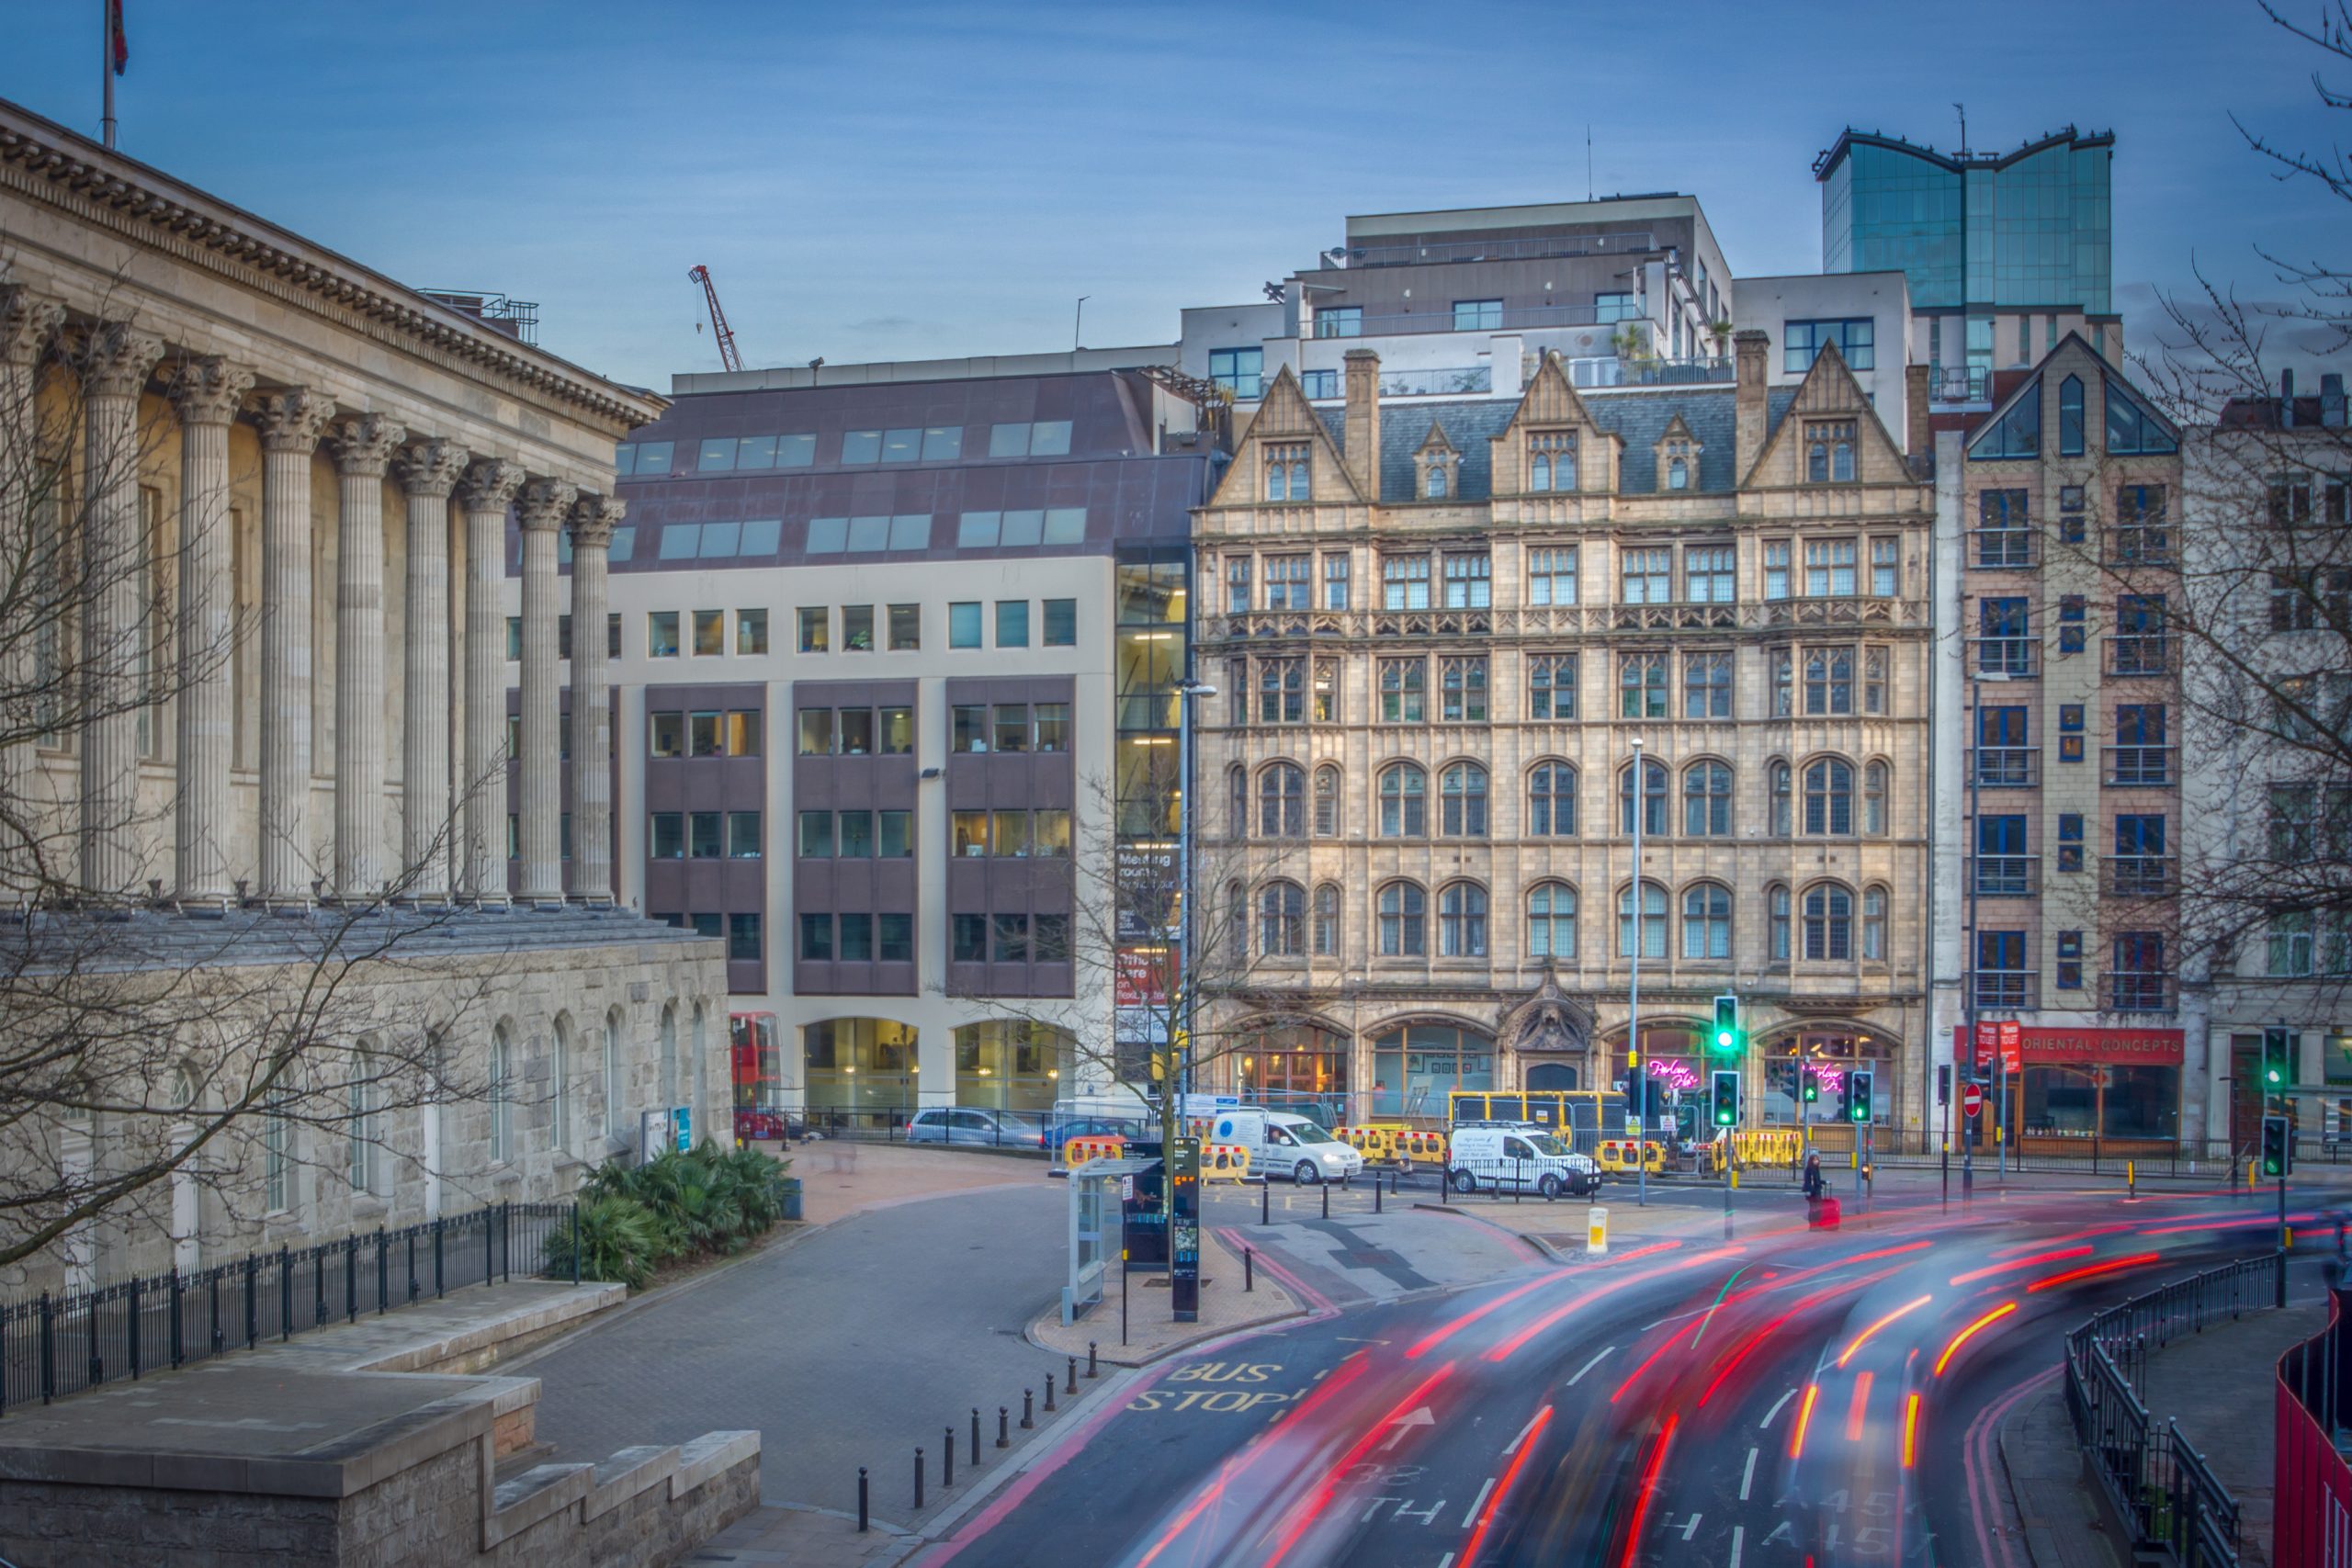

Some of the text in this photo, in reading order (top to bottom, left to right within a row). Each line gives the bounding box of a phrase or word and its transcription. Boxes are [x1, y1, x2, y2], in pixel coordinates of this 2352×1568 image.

[2021, 1037, 2181, 1053] ORIENTAL CONCEPTS
[1165, 1361, 1284, 1383] BUS
[1125, 1388, 1290, 1413] STOP
